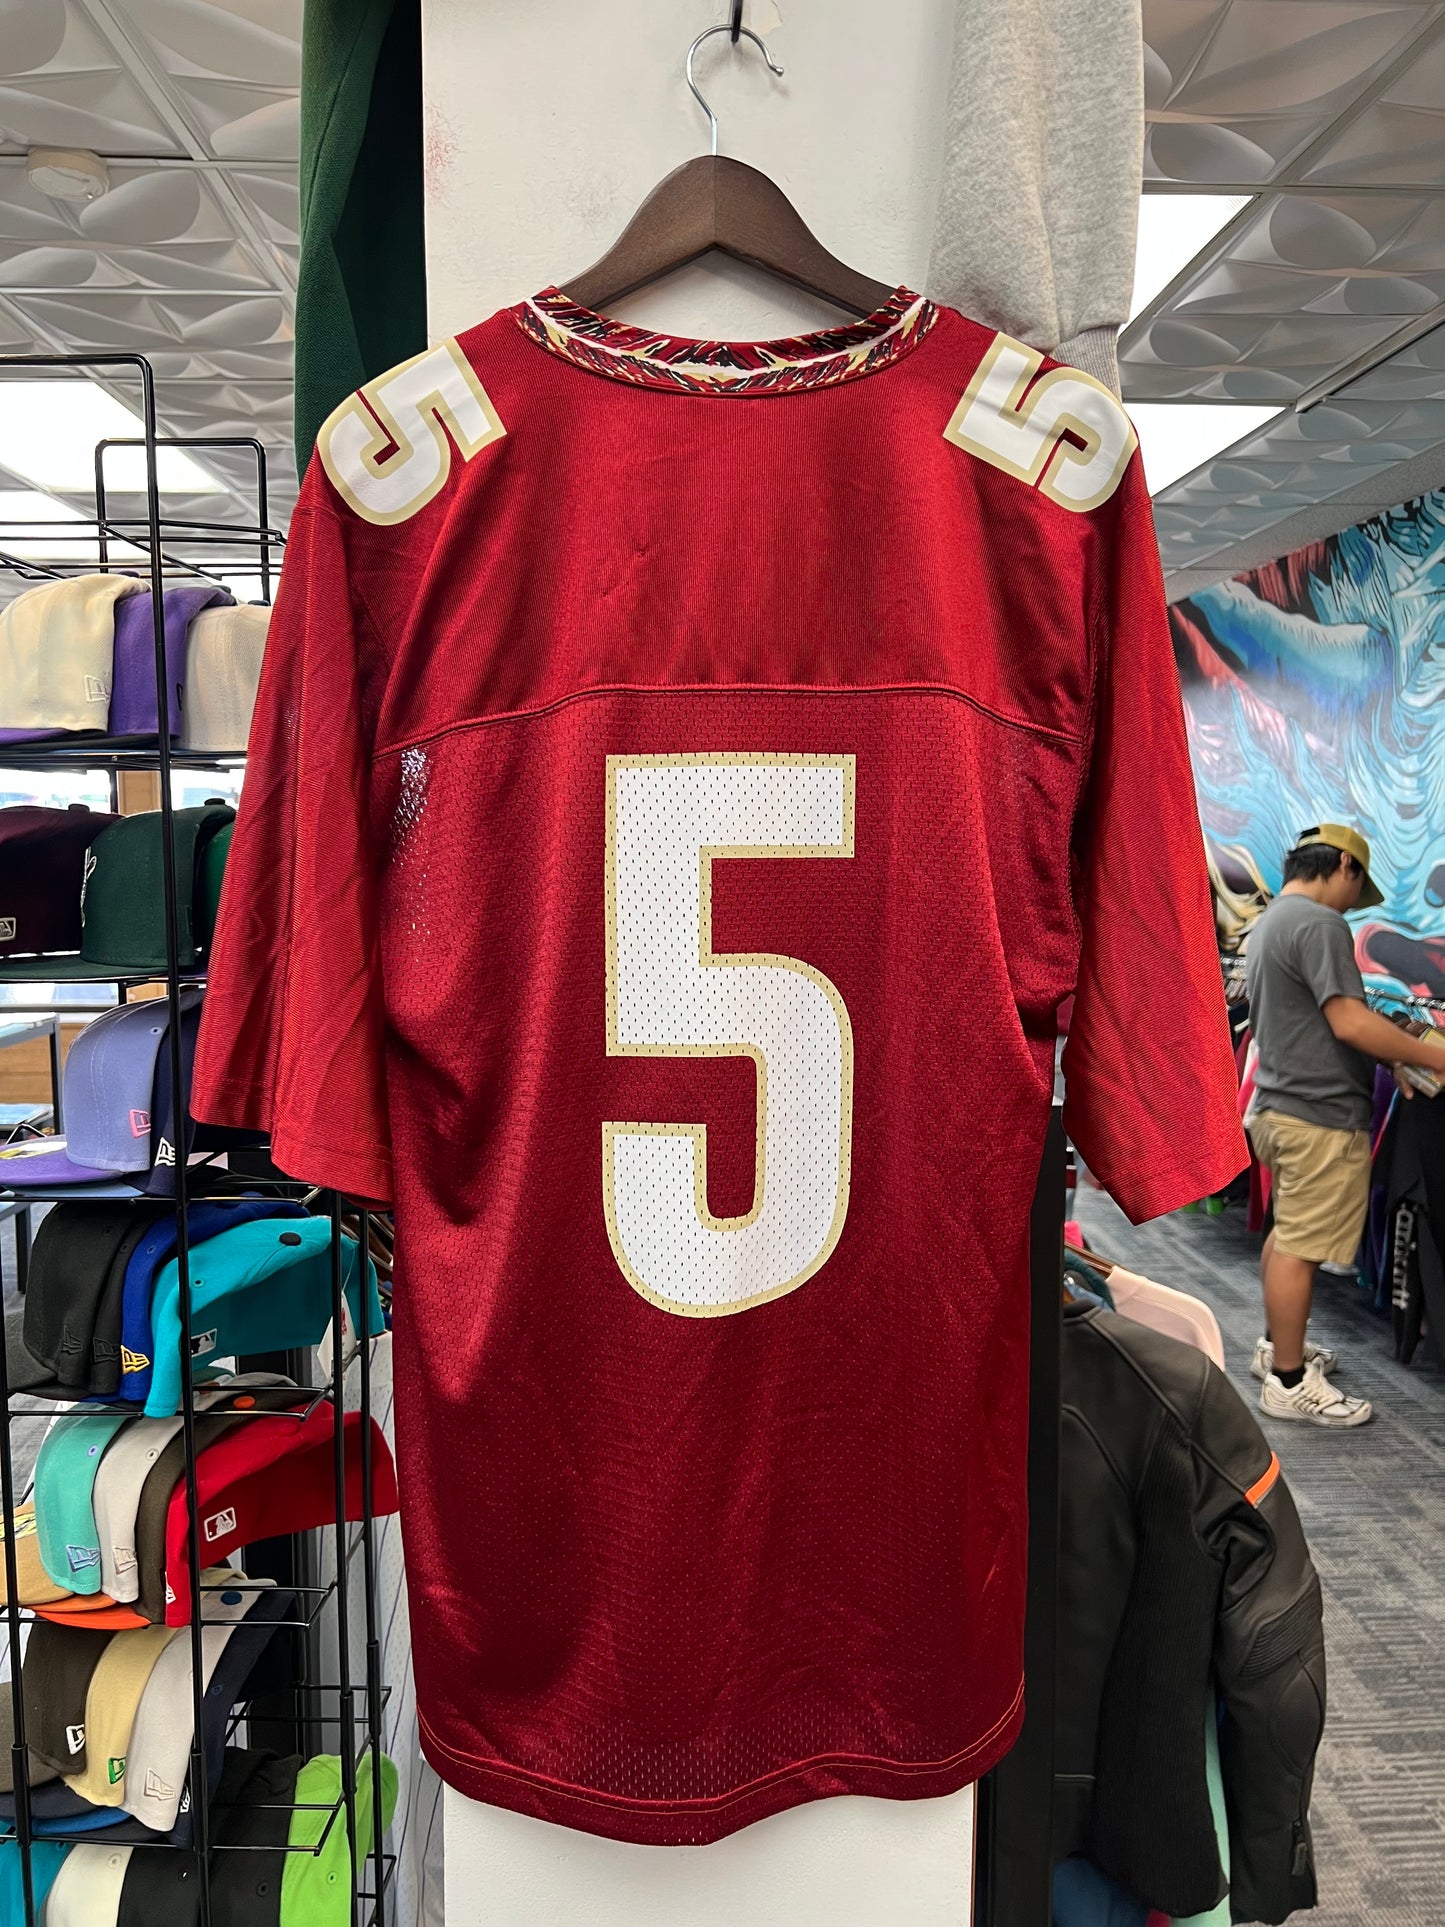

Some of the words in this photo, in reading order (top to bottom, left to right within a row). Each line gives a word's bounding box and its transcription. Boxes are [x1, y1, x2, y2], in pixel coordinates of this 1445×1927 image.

[315, 333, 508, 526] 5
[943, 333, 1138, 513] 5
[602, 750, 857, 1320] 5
